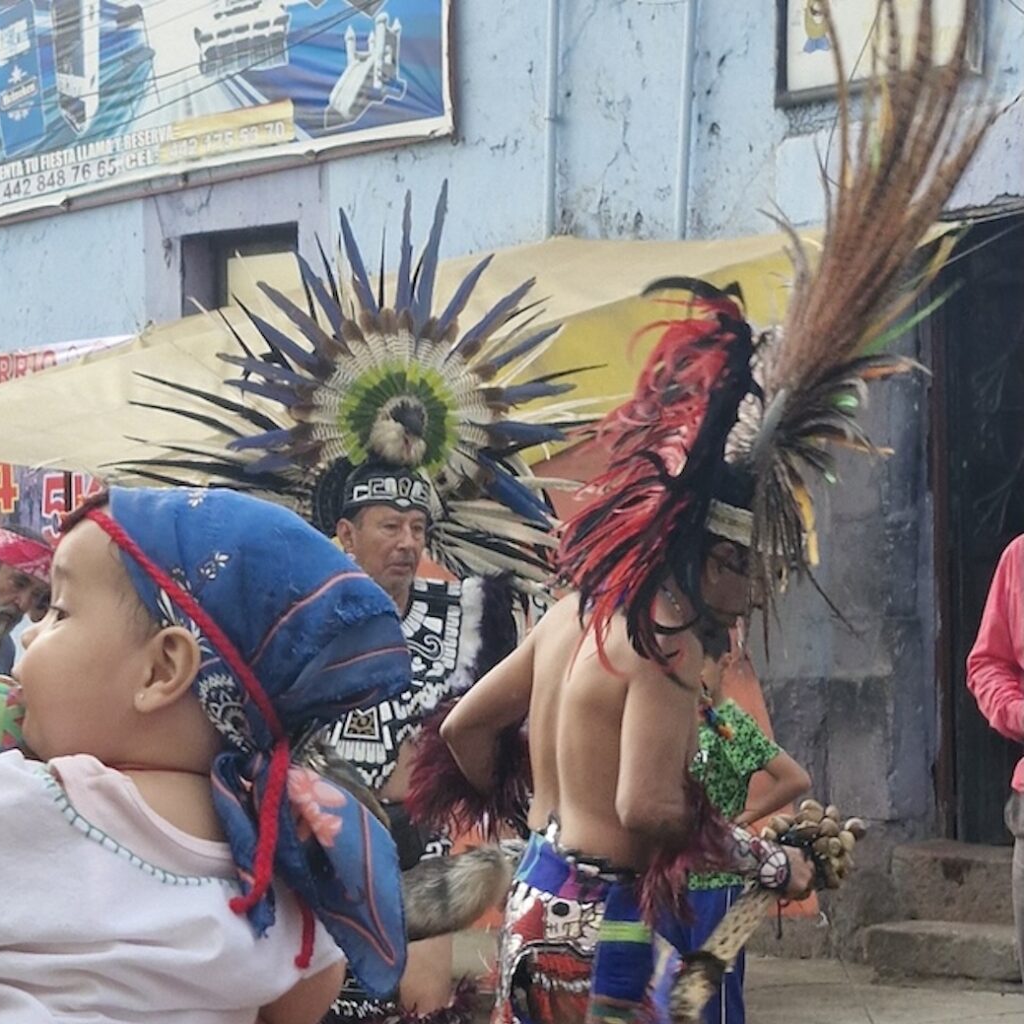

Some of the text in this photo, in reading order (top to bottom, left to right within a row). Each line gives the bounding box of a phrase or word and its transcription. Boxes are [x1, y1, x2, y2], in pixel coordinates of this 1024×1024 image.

[40, 148, 76, 170] FIESTA
[124, 125, 172, 149] RESERVA
[264, 121, 285, 139] 70
[3, 158, 117, 199] 442 848 76 65
